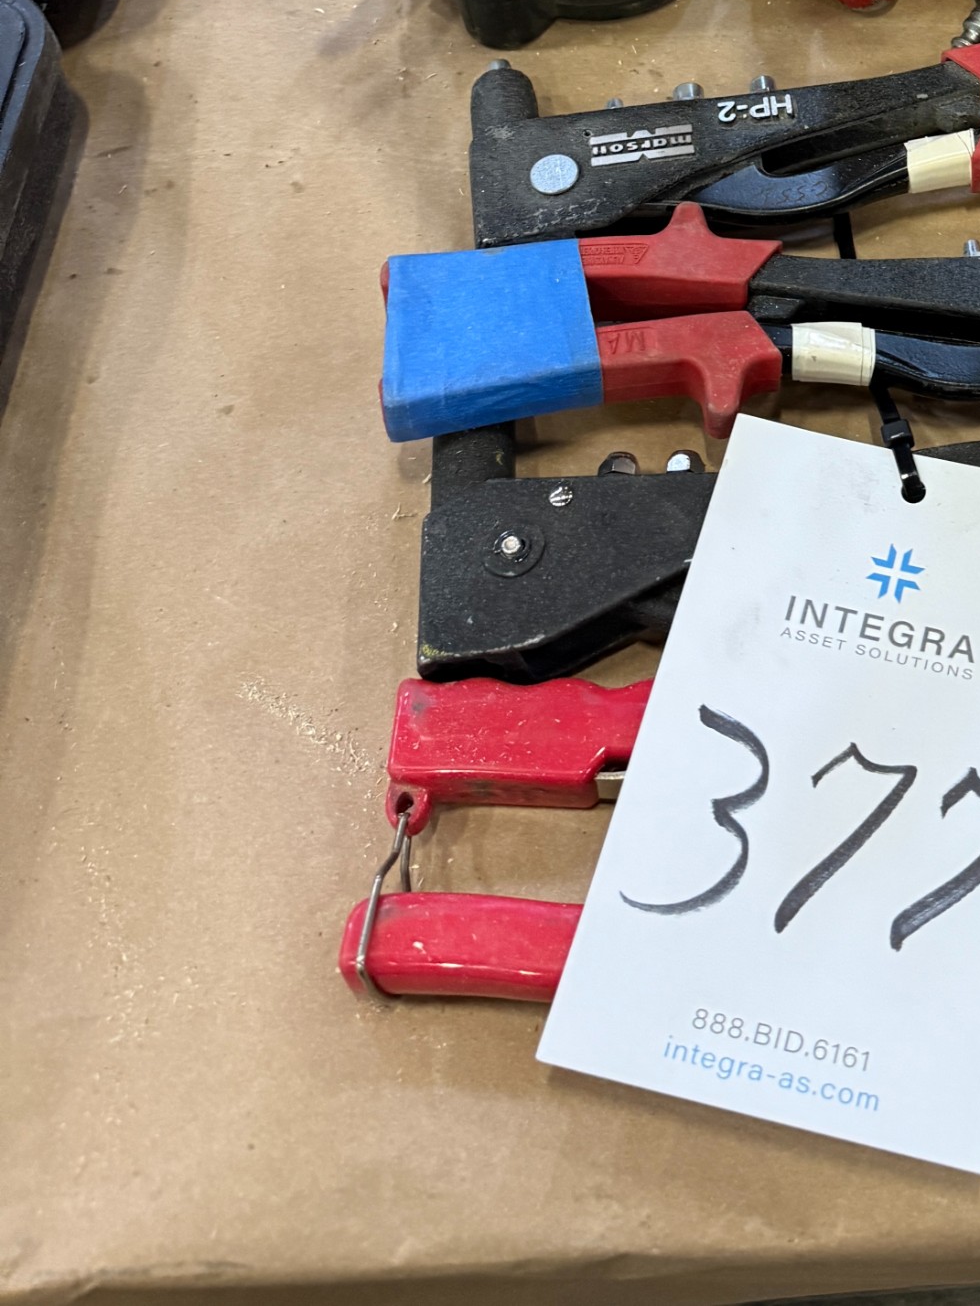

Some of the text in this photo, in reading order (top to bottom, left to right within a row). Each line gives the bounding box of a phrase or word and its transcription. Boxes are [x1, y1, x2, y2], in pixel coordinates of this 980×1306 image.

[717, 93, 793, 124] HP-2
[780, 626, 974, 681] ASSET SOLUTIONS
[785, 595, 975, 664] INTEGRA
[691, 1007, 872, 1072] 888.BID.6161
[663, 1035, 880, 1114] integra-as.com
